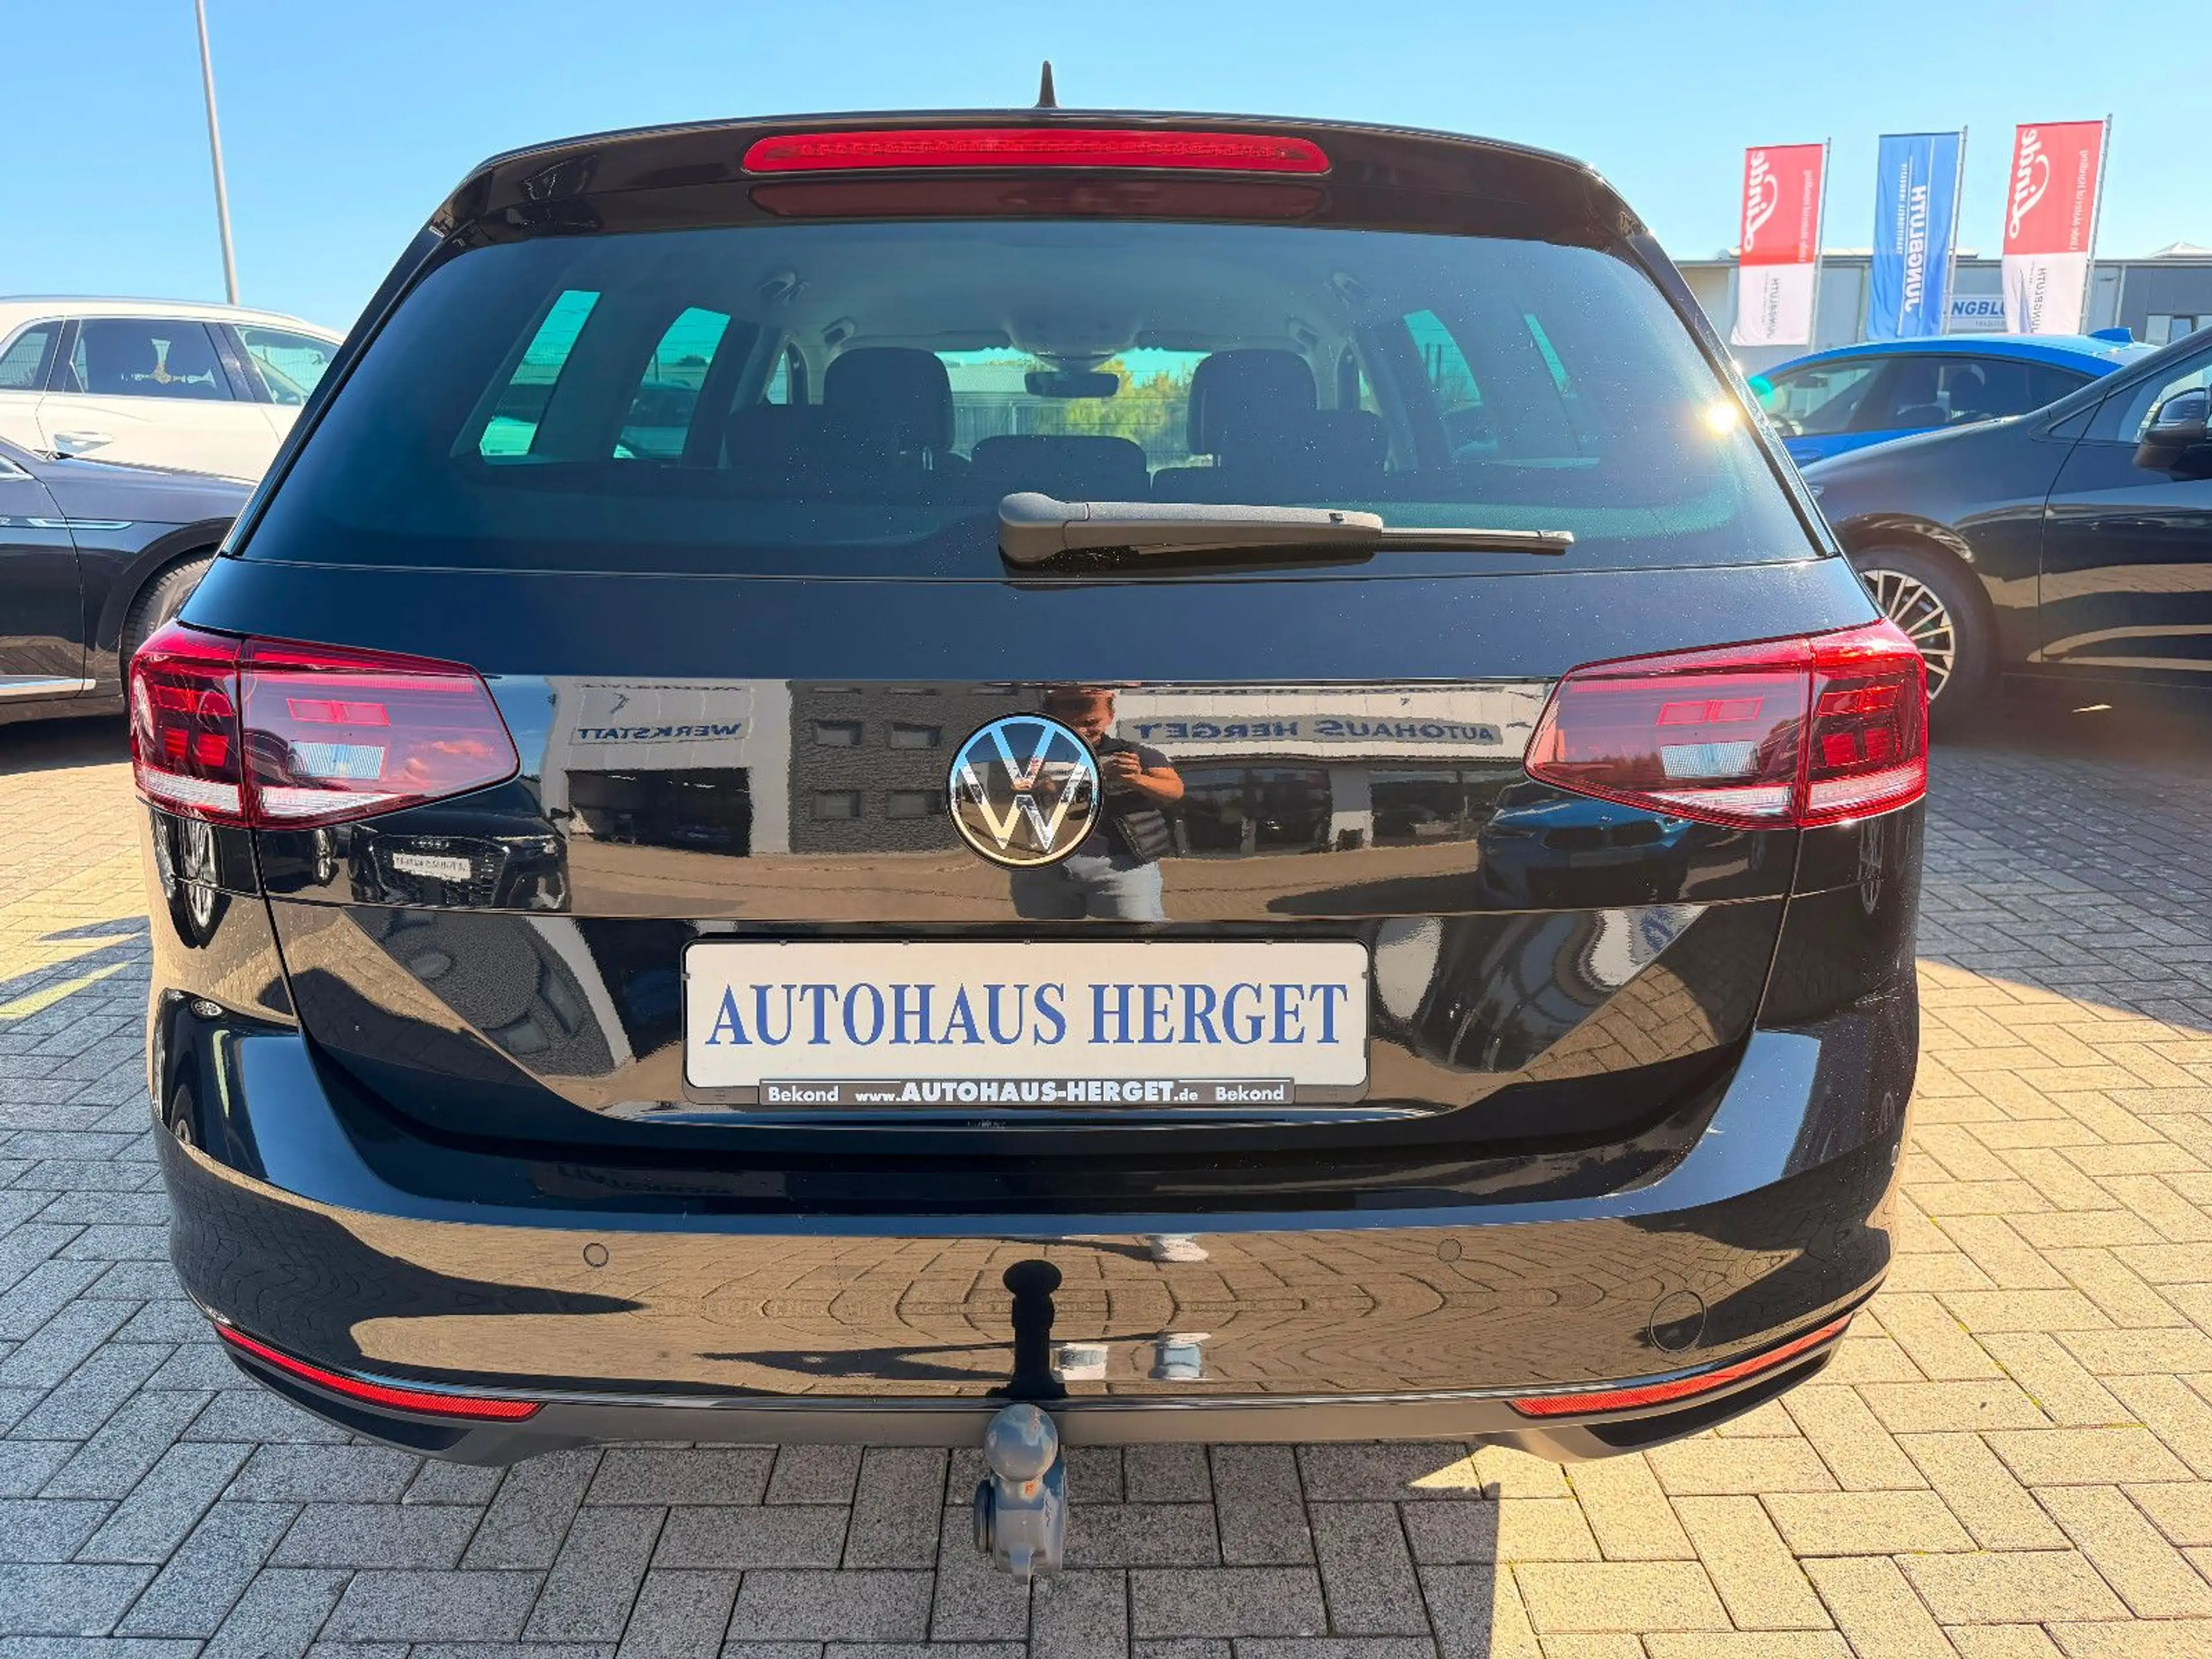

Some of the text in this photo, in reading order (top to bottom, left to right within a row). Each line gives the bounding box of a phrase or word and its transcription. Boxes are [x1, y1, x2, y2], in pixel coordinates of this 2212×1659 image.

[705, 983, 1348, 1046] AUTOHAUS HERGET
[768, 1081, 1284, 1102] Bekond www.AUTOHAUS-HERGET.de Bekond
